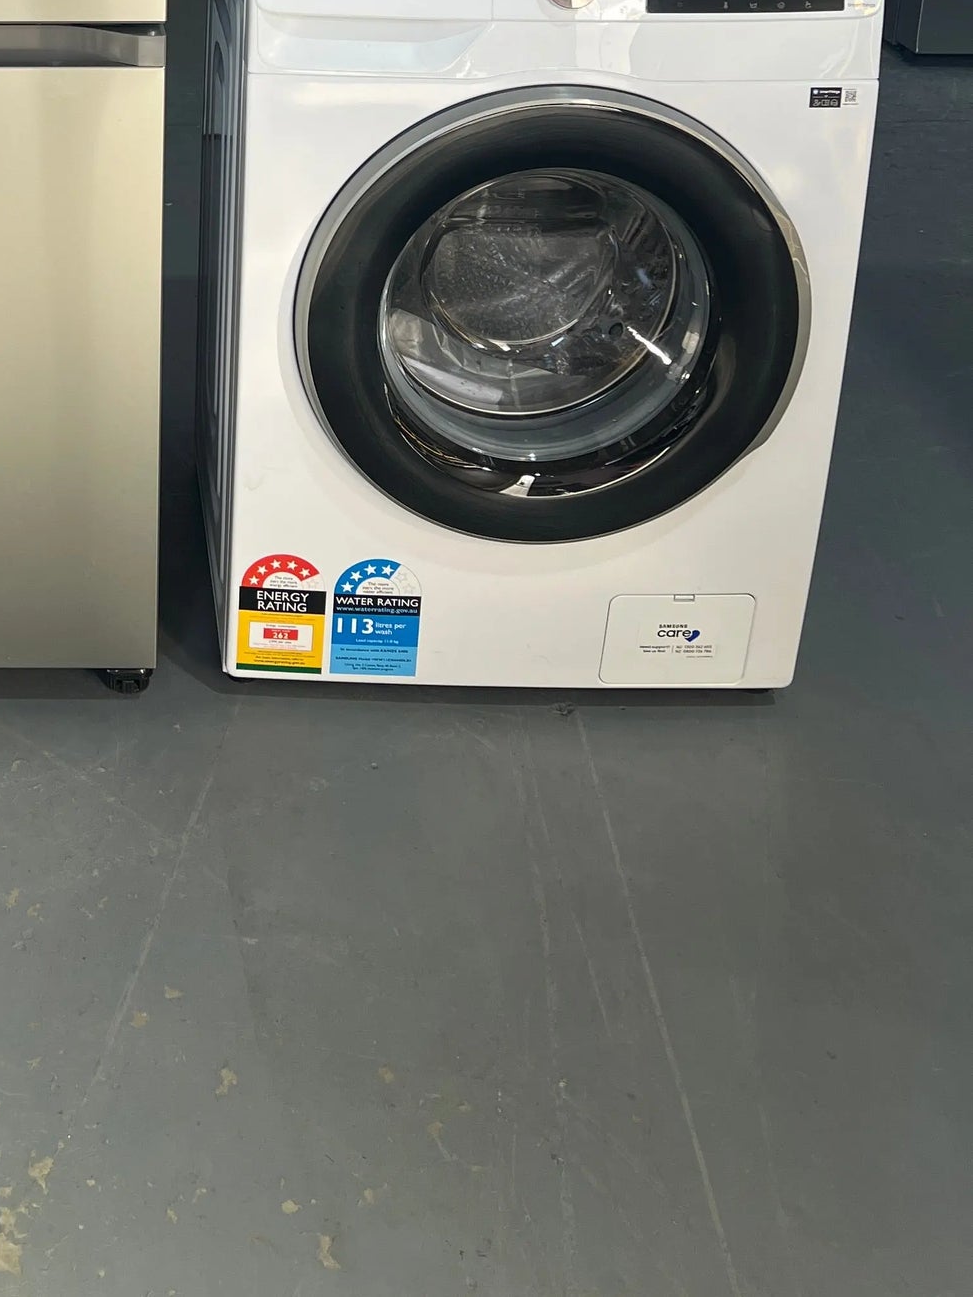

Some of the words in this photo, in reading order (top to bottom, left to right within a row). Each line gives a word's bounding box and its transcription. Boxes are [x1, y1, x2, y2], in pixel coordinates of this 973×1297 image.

[256, 590, 309, 602] ENERGY
[336, 596, 374, 606] WATER
[377, 598, 419, 607] RATING
[257, 601, 307, 612] RATING
[336, 606, 418, 614] www.waterrating.gov.au
[337, 617, 374, 634] 113
[394, 623, 407, 631] per
[657, 629, 691, 638] care
